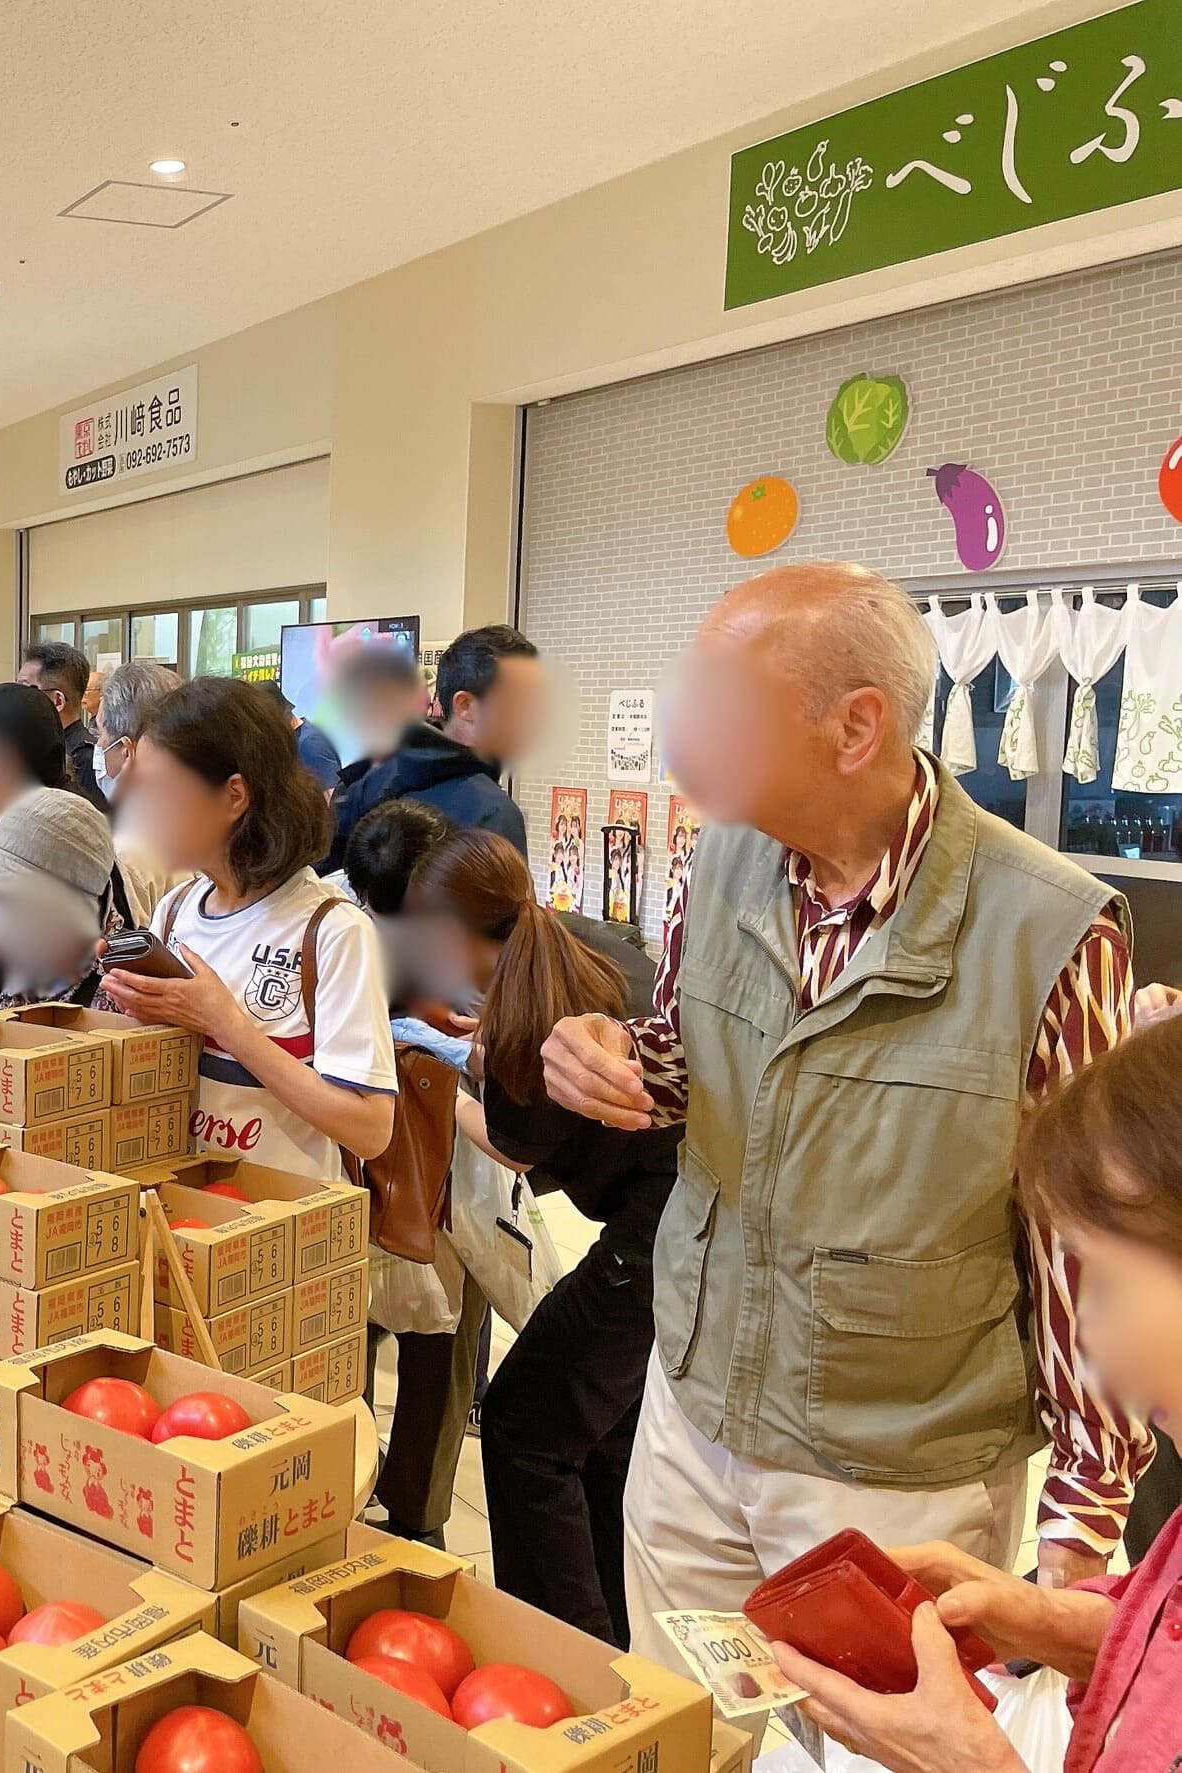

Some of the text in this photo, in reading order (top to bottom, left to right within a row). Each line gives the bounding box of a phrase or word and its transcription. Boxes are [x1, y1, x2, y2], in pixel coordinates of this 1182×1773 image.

[885, 54, 1182, 204] べじふ
[126, 433, 191, 471] 092-692-7573
[255, 973, 290, 1011] C
[166, 1051, 184, 1068] 5 6
[75, 1065, 96, 1083] 5 6
[165, 1068, 183, 1084] 7 8
[1, 1058, 13, 1115] とまと
[75, 1083, 96, 1101] 7 8
[155, 1117, 174, 1134] 5 6
[188, 1109, 263, 1151] erse
[74, 1137, 95, 1155] 5 6
[154, 1134, 174, 1151] 7 8
[96, 1215, 119, 1236] 5 6
[337, 1216, 355, 1235] 5 6
[10, 1207, 24, 1274] とまと
[95, 1236, 118, 1257] 7 8
[336, 1235, 355, 1253] 7 8
[257, 1244, 277, 1264] 5 6
[257, 1263, 277, 1283] 7 8
[96, 1296, 120, 1318] 5 6
[336, 1287, 355, 1306] 5 6
[11, 1291, 25, 1356] とまと
[336, 1305, 354, 1325] 7 8
[181, 1316, 194, 1358] とま
[257, 1316, 277, 1337] 5 6
[257, 1335, 277, 1356] 7 8
[334, 1355, 352, 1376] 5 6
[334, 1374, 352, 1394] 7 8
[269, 1449, 311, 1496] 元岡
[174, 1464, 195, 1564] とまと
[289, 1553, 387, 1596] 福岡市内産
[666, 1614, 697, 1625] 千円
[252, 1627, 278, 1670] 元
[703, 1637, 753, 1664] 1000
